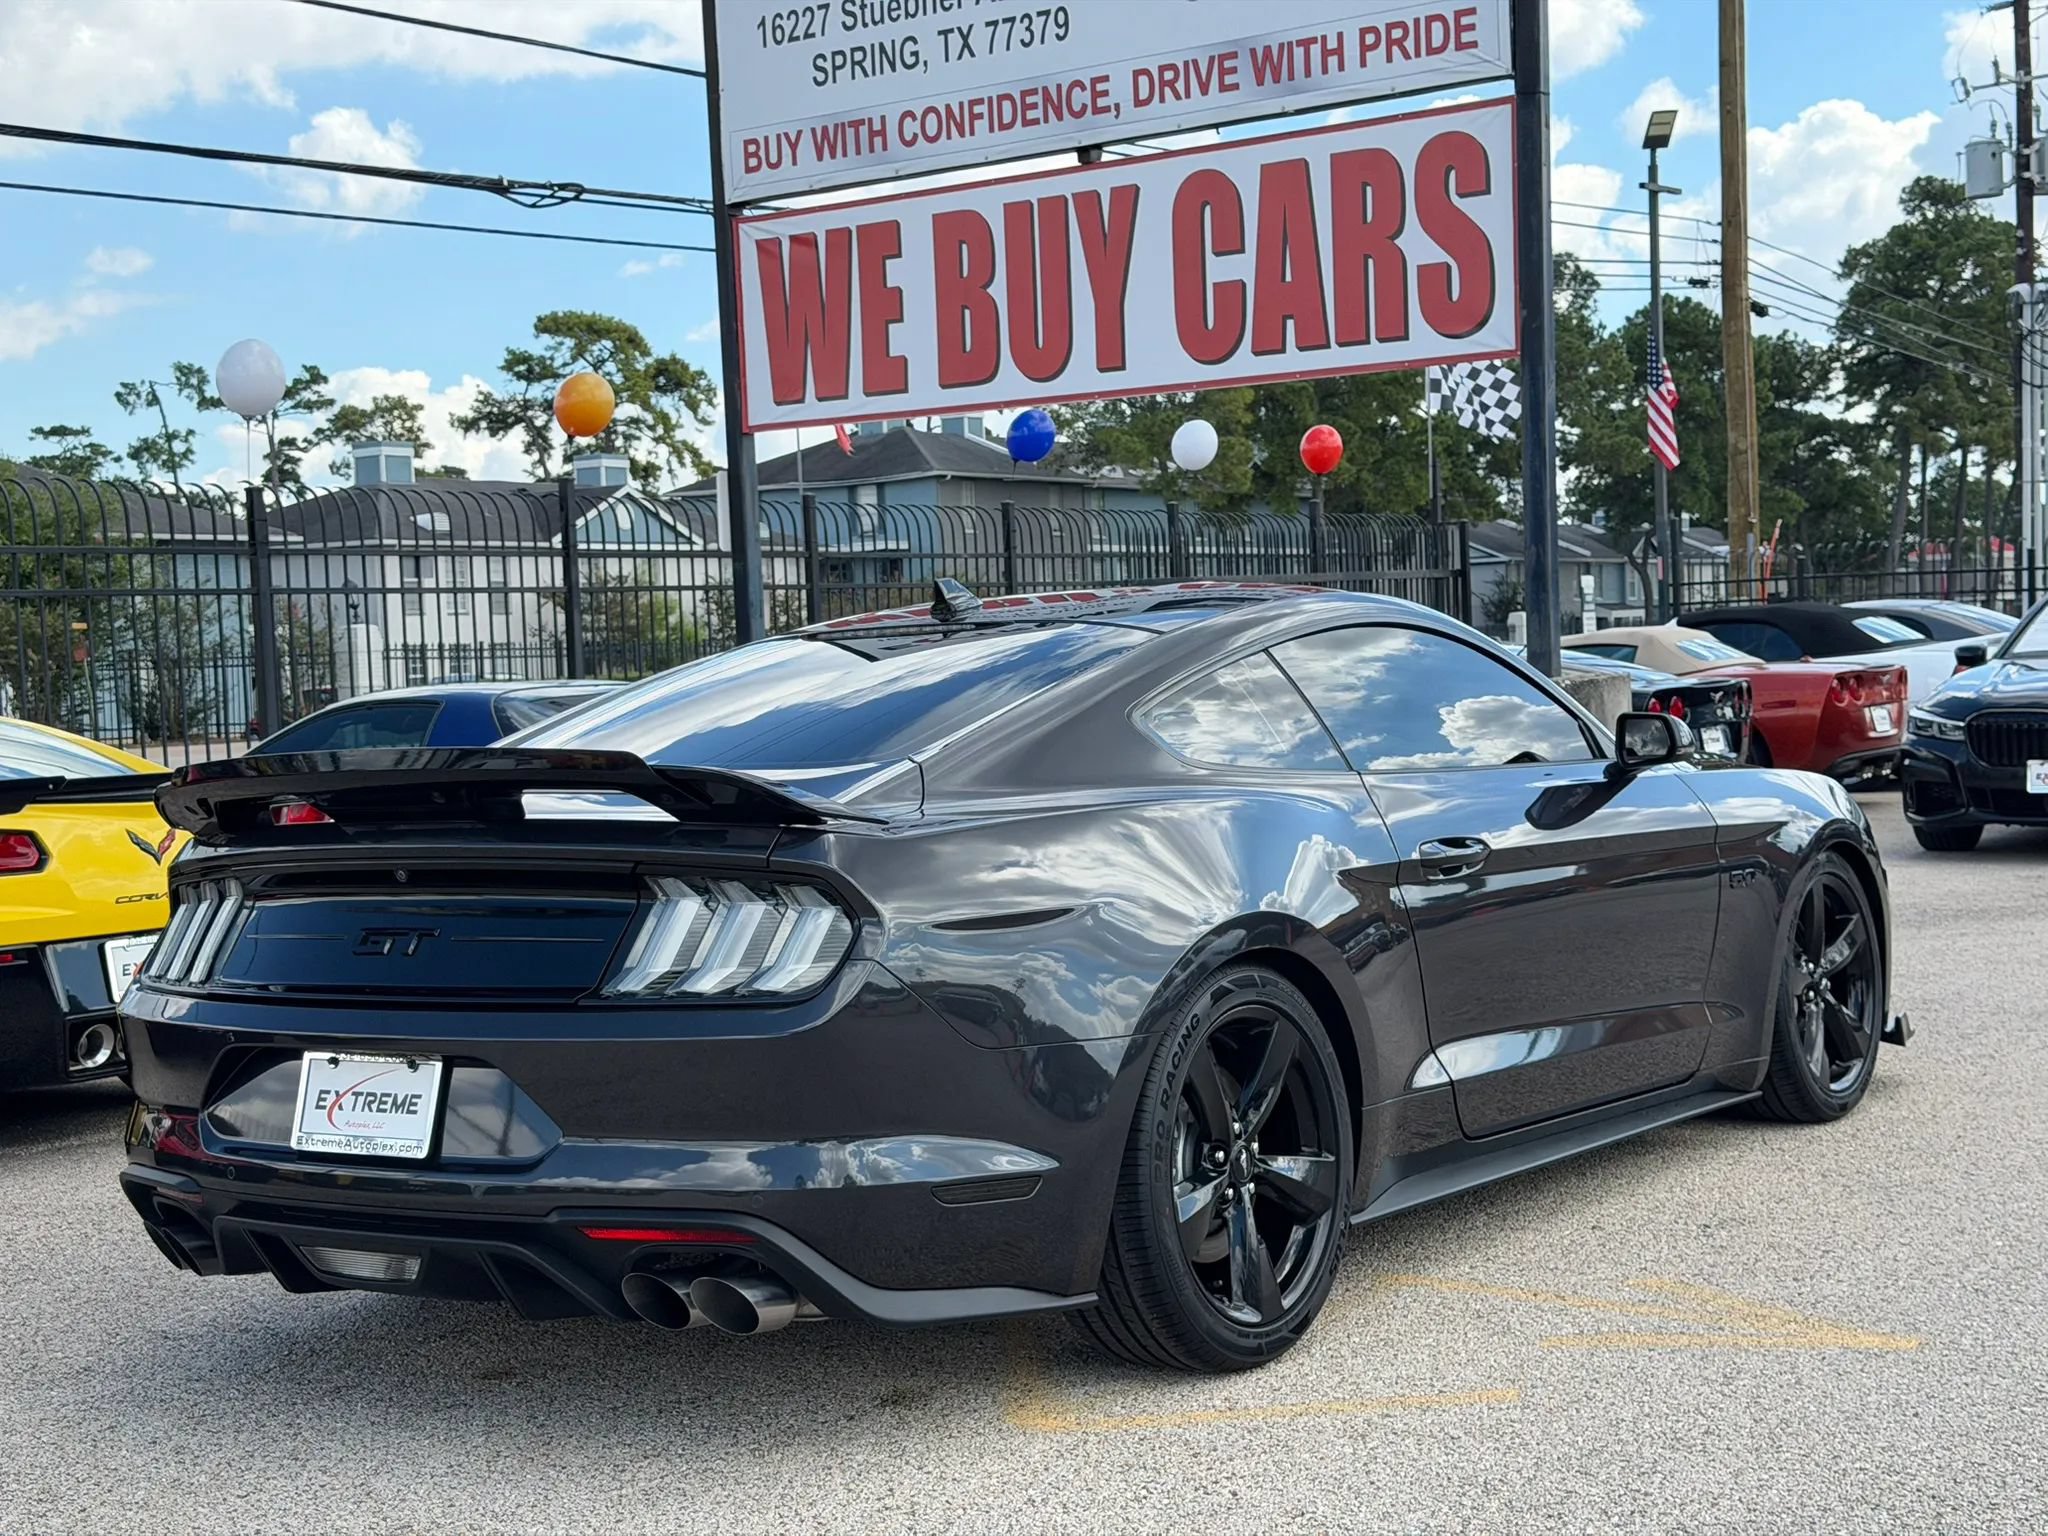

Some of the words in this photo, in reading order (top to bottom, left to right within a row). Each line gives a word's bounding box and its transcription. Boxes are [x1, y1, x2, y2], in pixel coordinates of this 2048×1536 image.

[756, 2, 831, 48] 16227
[811, 35, 929, 88] SPRING,
[937, 23, 976, 64] TX
[985, 6, 1070, 56] 77379
[743, 129, 803, 174] BUY
[811, 114, 888, 162] WITH
[897, 74, 1121, 148] CONFIDENCE,
[1132, 51, 1240, 108] DRIVE
[1249, 31, 1345, 87] WITH
[1358, 7, 1478, 68] PRIDE
[755, 218, 910, 407] WE
[932, 184, 1140, 390] BUY
[1171, 130, 1496, 366] CARS
[352, 927, 440, 956] GT
[1160, 1012, 1200, 1112] RACING
[314, 1089, 423, 1115] EXTREME
[296, 1135, 423, 1154] ExtremeAutoplex.com
